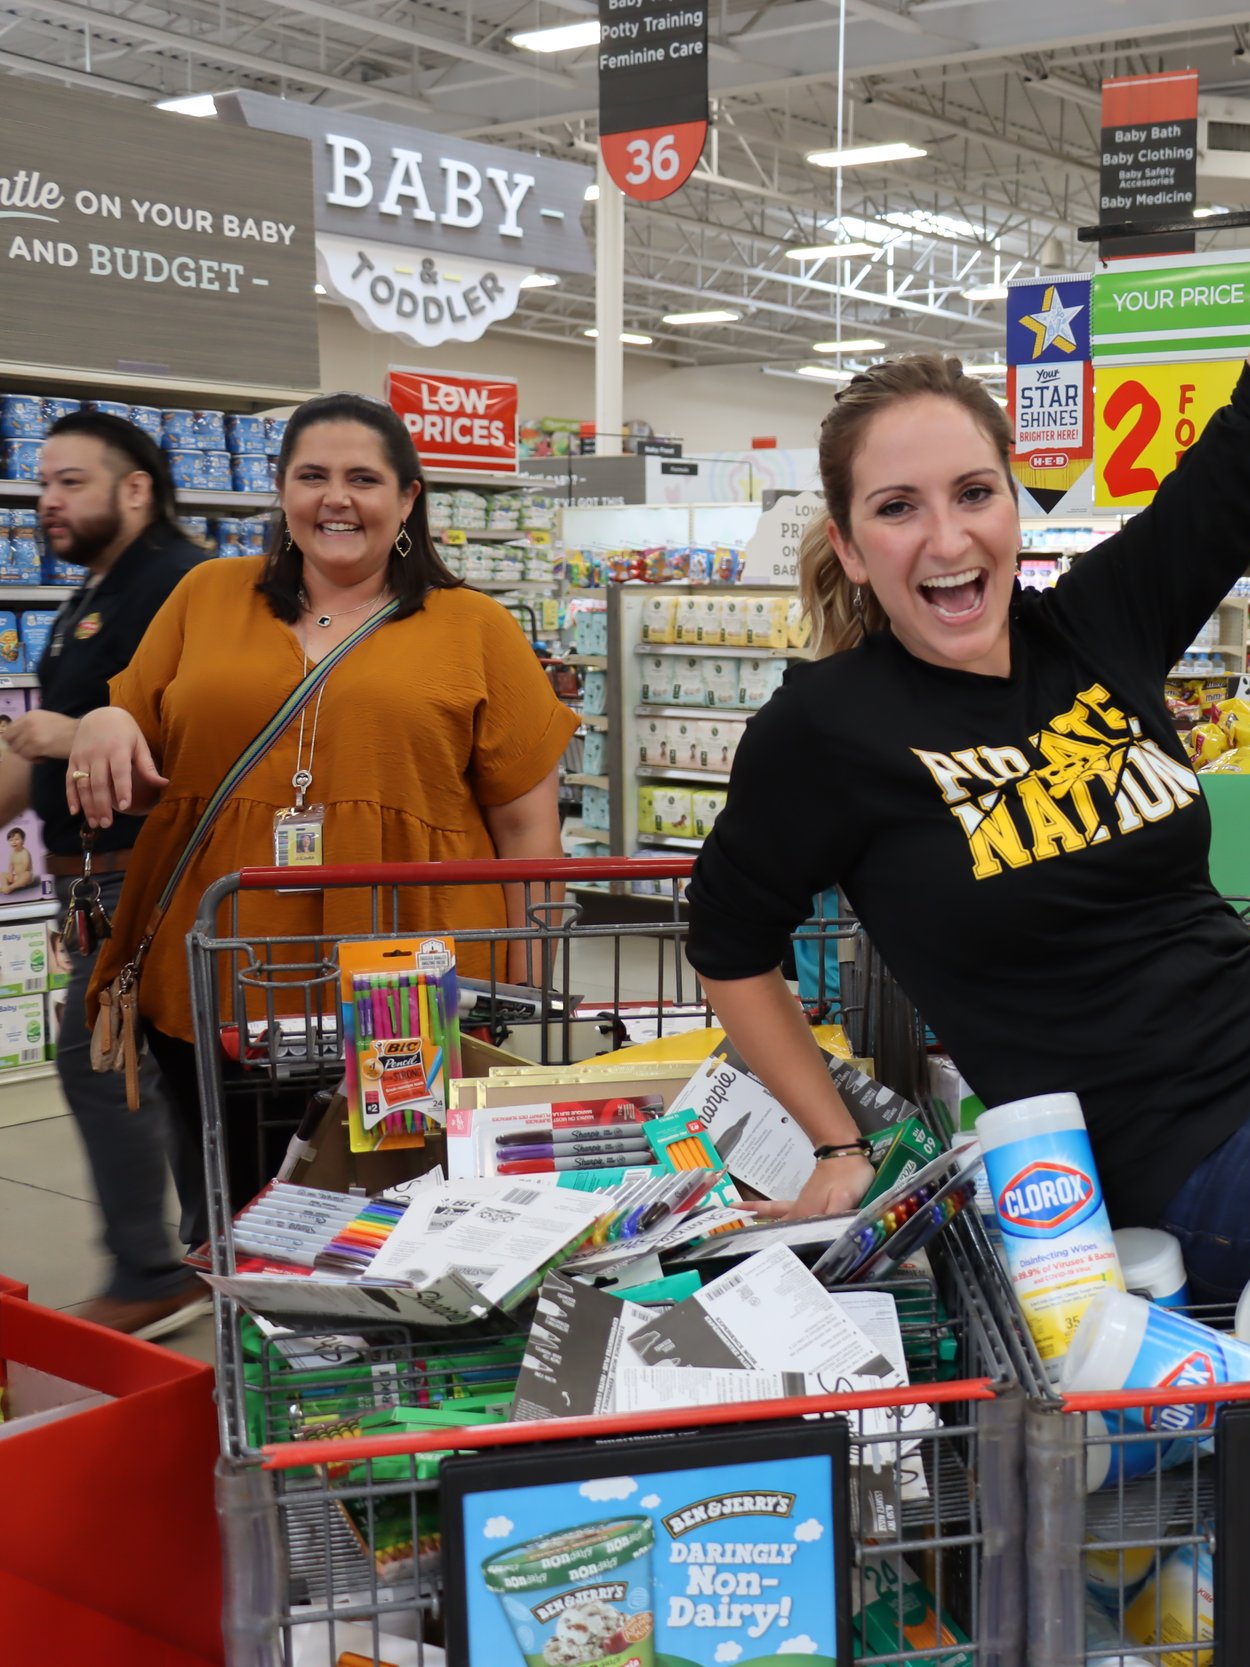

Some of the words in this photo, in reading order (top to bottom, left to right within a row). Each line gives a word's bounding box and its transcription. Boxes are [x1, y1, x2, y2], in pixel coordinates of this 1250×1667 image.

[600, 21, 639, 40] Potty
[643, 11, 703, 33] Training
[600, 48, 665, 70] Feminine
[669, 41, 703, 58] Care
[1115, 129, 1147, 143] Baby
[1151, 125, 1181, 139] Bath
[625, 134, 680, 185] 36
[1103, 152, 1134, 166] Baby
[1138, 147, 1194, 162] Clothing
[325, 133, 535, 238] BABY
[1119, 169, 1142, 179] Baby
[1145, 167, 1175, 177] Safety
[1119, 176, 1174, 189] Accessories
[1101, 195, 1132, 209] Baby
[1136, 191, 1192, 205] Medicine
[75, 190, 122, 219] ON
[131, 199, 213, 233] YOUR
[223, 214, 296, 245] BABY
[8, 235, 79, 267] AND
[88, 243, 244, 293] BUDGET
[420, 257, 438, 285] &
[351, 251, 505, 325] TODDLER
[1113, 289, 1175, 312] YOUR
[1180, 284, 1245, 307] PRICE
[1036, 369, 1060, 382] Your
[421, 383, 489, 415] LOW
[1021, 384, 1078, 409] STAR
[403, 413, 505, 447] PRICES
[1020, 410, 1078, 428] SHINES
[1020, 430, 1055, 442] BRIGHTER
[1057, 429, 1079, 441] HERE!
[1103, 380, 1161, 498] 2
[773, 564, 797, 576] BAB
[950, 738, 1201, 881] NATION
[2, 932, 21, 942] Baby
[388, 1042, 418, 1053] BIC
[385, 1055, 417, 1070] Pencil
[924, 1137, 936, 1155] 60
[573, 1156, 604, 1167] Sharpie
[1004, 1174, 1087, 1218] CLOROX
[1020, 1248, 1069, 1268] Disinfecting
[1070, 1242, 1098, 1256] Wipes
[1018, 1267, 1041, 1281] 99.9%
[1043, 1264, 1052, 1274] of
[1065, 1315, 1080, 1331] 35
[669, 1543, 798, 1564] DARINGLY
[686, 1565, 778, 1596] Non-
[667, 1595, 792, 1638] Dairy!
